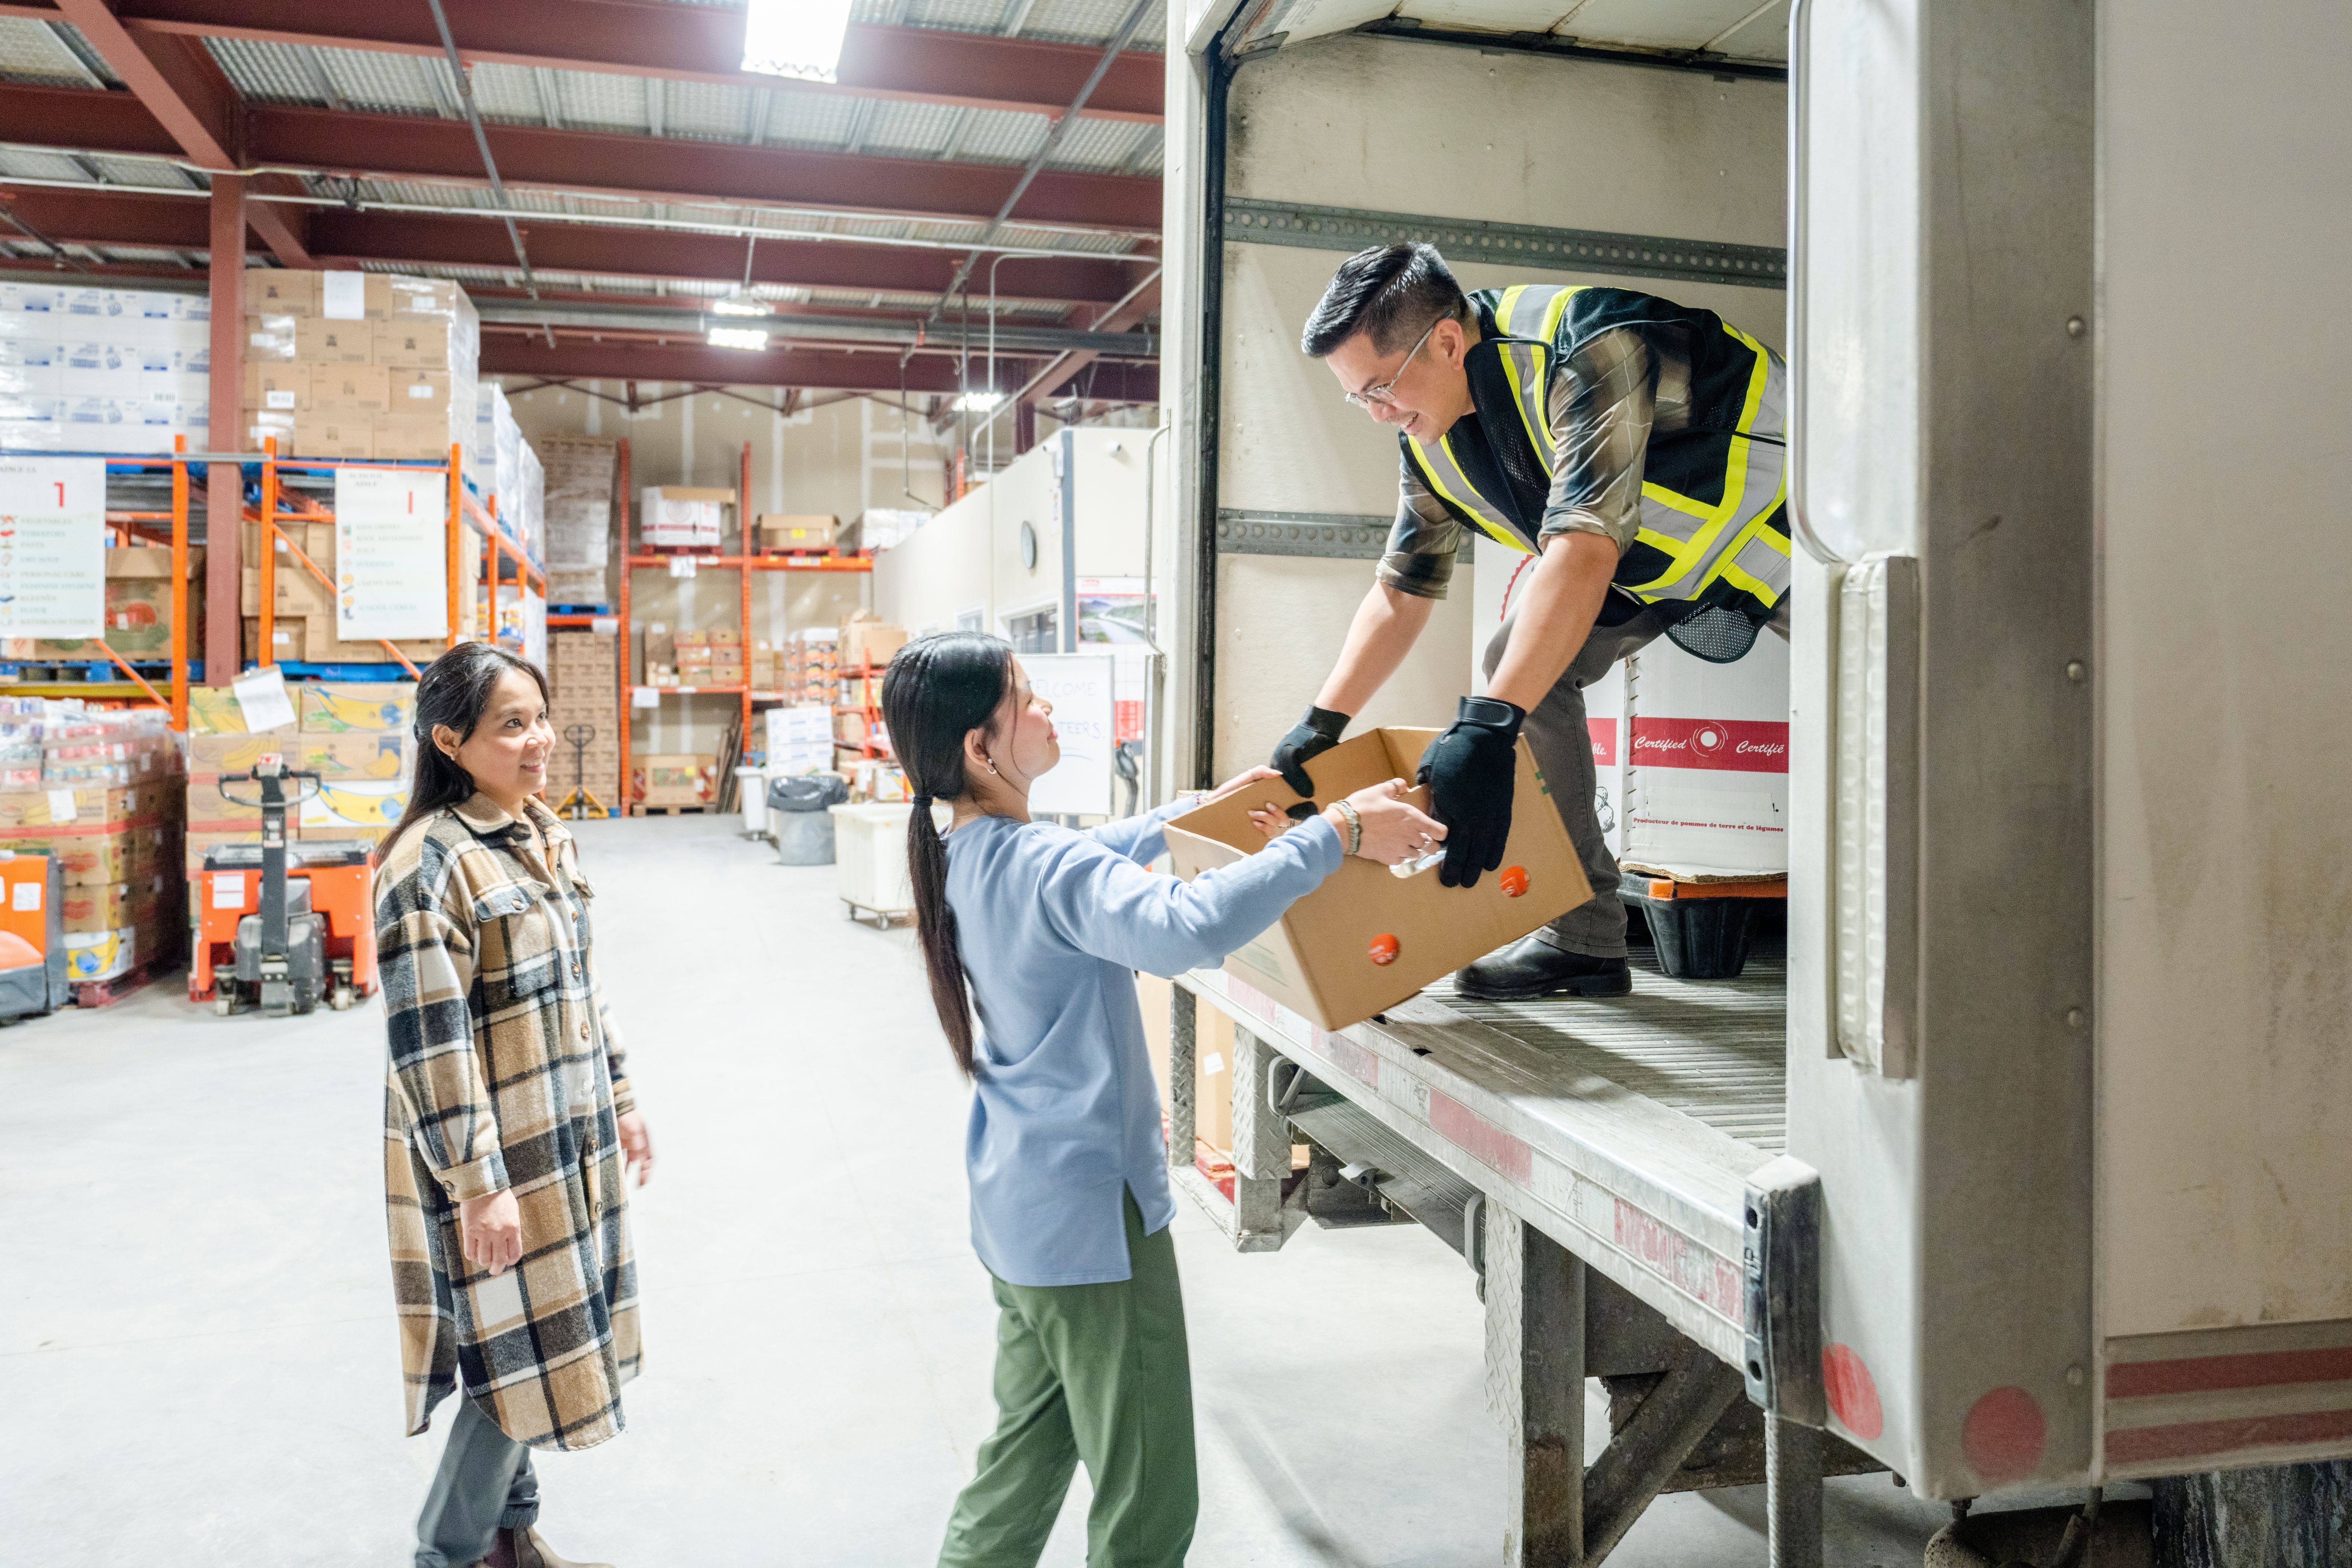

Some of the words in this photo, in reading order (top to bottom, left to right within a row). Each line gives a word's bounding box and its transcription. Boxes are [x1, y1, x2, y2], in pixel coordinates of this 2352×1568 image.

[54, 482, 64, 507] 1
[1592, 742, 1606, 755] ble.
[1634, 736, 1687, 751] Certified
